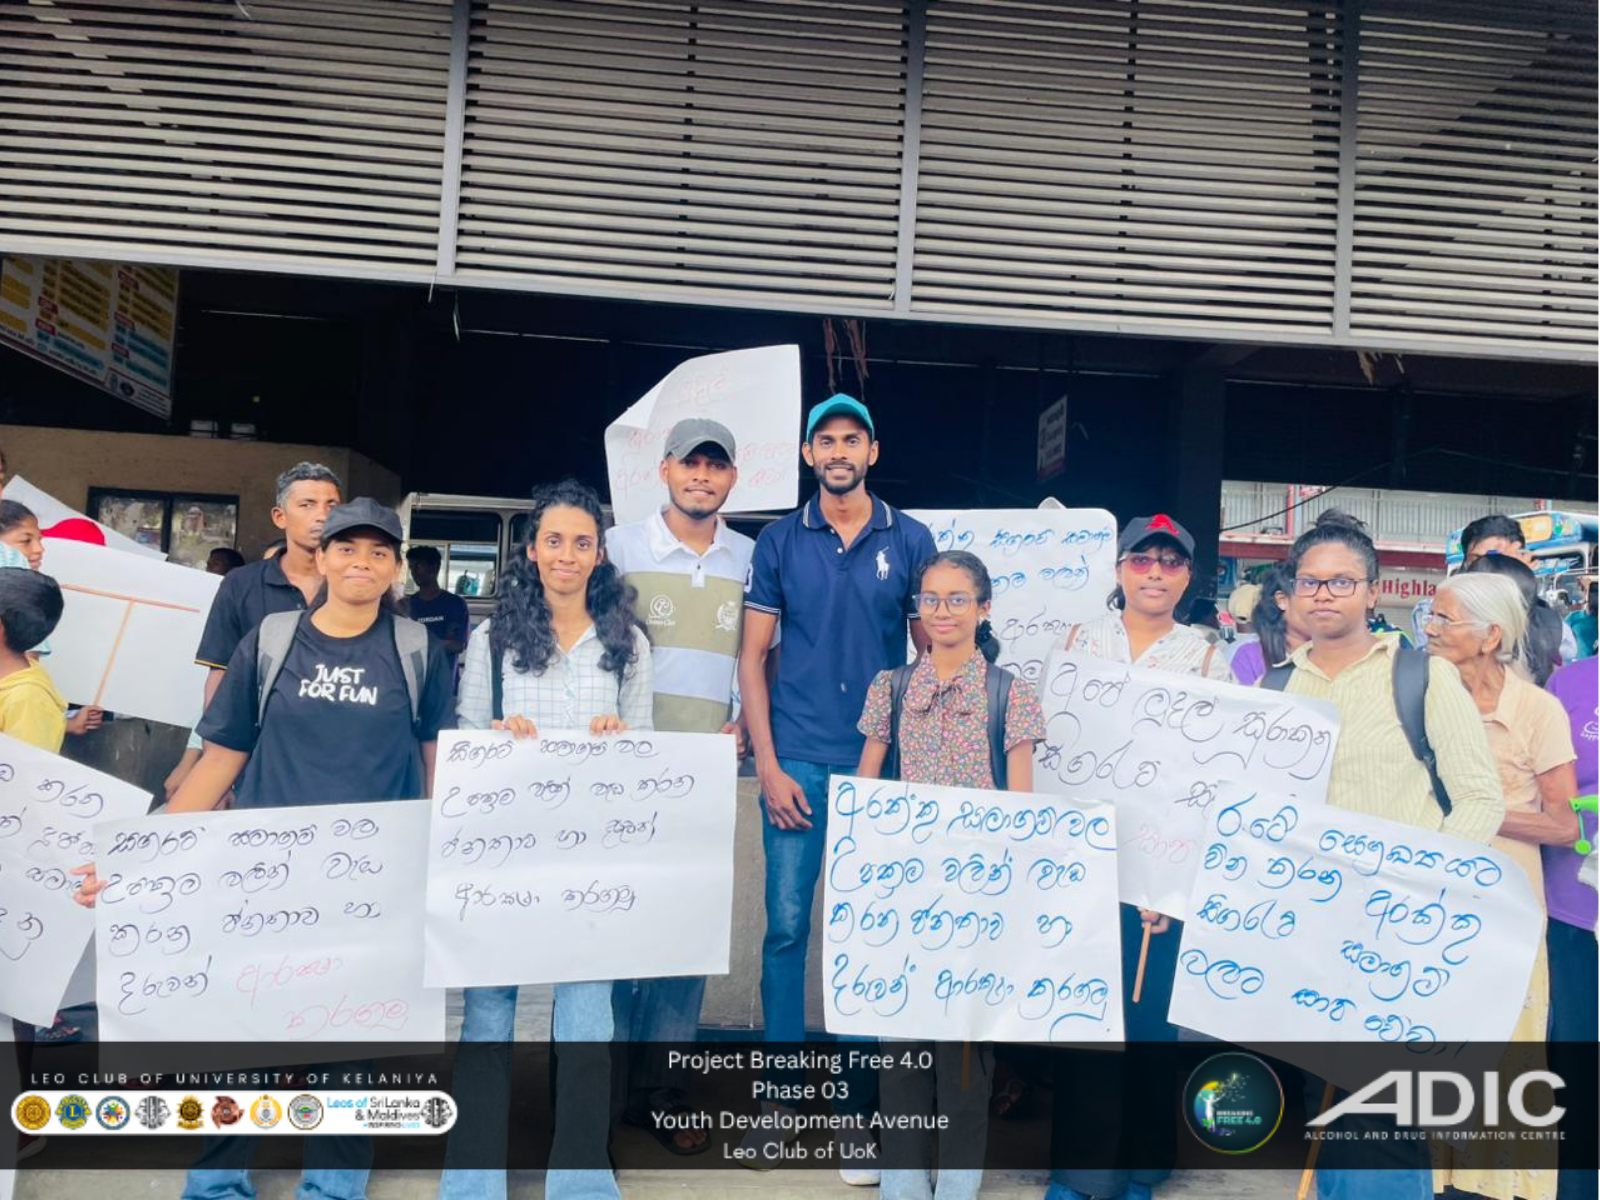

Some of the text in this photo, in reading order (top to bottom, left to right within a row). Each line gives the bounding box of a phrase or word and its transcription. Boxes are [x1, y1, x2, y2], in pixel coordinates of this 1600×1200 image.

[1382, 577, 1437, 599] Highla
[315, 664, 366, 684] JUST
[298, 678, 378, 706] FOR FUN
